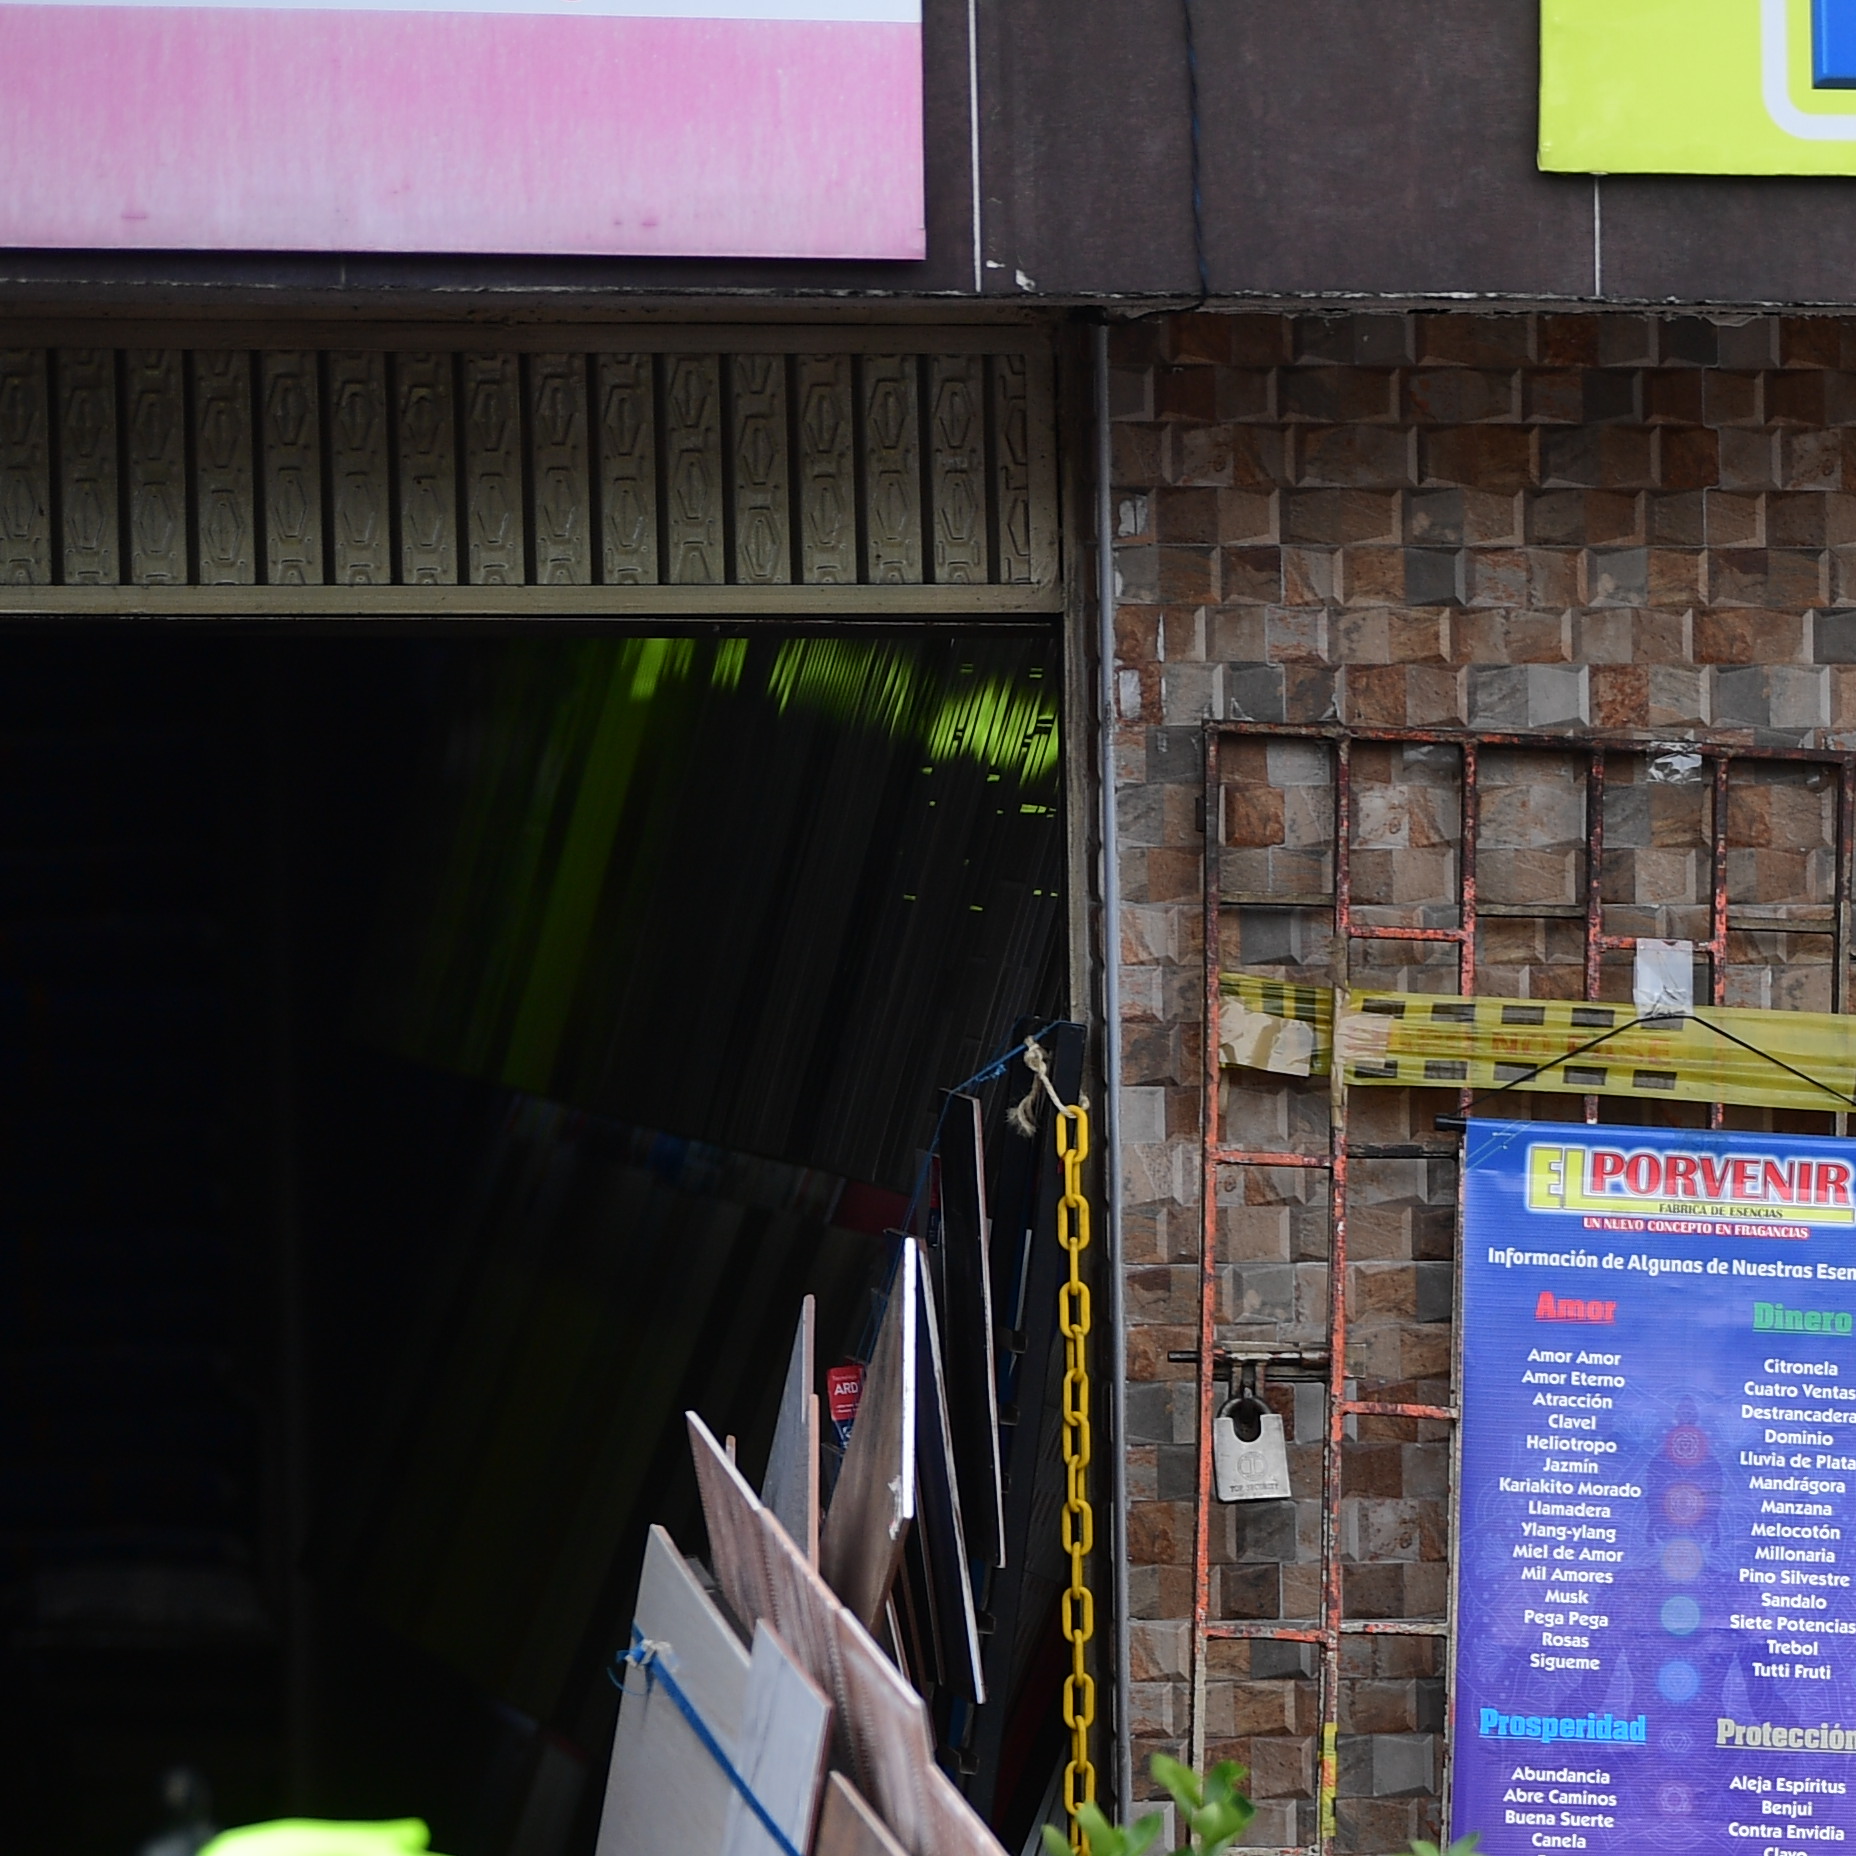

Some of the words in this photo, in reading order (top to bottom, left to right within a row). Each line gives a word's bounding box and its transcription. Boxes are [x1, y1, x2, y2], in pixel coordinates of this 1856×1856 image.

[1529, 1147, 1585, 1209] EL
[1591, 1152, 1849, 1205] PORVENIR
[1660, 1204, 1707, 1216] FABRICA
[1711, 1206, 1726, 1216] DE
[1729, 1207, 1783, 1218] ESENCIAS
[1584, 1218, 1601, 1229] UN
[1604, 1219, 1644, 1231] NUEVO
[1648, 1221, 1711, 1234] CONCEPTO
[1716, 1223, 1732, 1235] EN
[1735, 1225, 1808, 1239] FRAGANCIAS
[1488, 1247, 1599, 1269] Información
[1601, 1252, 1625, 1270] de
[1626, 1254, 1703, 1277] Algunas
[1706, 1257, 1729, 1275] de
[1732, 1259, 1813, 1279] Nuestras
[1536, 1291, 1616, 1324] Amor
[1753, 1302, 1852, 1334] Dinero
[1527, 1348, 1573, 1364] Amor
[1575, 1350, 1622, 1366] Amor
[1763, 1358, 1839, 1376] Citronela
[1521, 1369, 1567, 1385] Amor
[1570, 1371, 1626, 1388] Eterno
[1532, 1391, 1613, 1409] Atracción
[1743, 1381, 1799, 1398] Cuatro
[1801, 1383, 1856, 1401] Ventas
[1548, 1413, 1597, 1430] Clavel
[1526, 1434, 1617, 1456] Heliotropo
[1764, 1428, 1834, 1446] Dominio
[1542, 1457, 1599, 1474] Jazmín
[1739, 1450, 1786, 1468] Lluvia
[1789, 1453, 1813, 1469] de
[1816, 1454, 1856, 1471] Plata
[1499, 1476, 1574, 1495] Kariakito
[1577, 1481, 1642, 1498] Morado
[1748, 1475, 1846, 1495] Mandrágora
[1528, 1500, 1611, 1519] Llamadera
[1760, 1499, 1833, 1516] Manzana
[1521, 1521, 1617, 1544] Ylang-ylang
[1750, 1522, 1841, 1540] Melocotón
[1512, 1543, 1549, 1559] Miel
[1552, 1544, 1575, 1560] de
[1578, 1547, 1625, 1563] Amor
[1754, 1545, 1836, 1563] Millonaria
[1520, 1565, 1547, 1581] Mil
[1550, 1567, 1614, 1584] Amores
[1739, 1567, 1777, 1584] Pino
[1780, 1569, 1851, 1587] Silvestre
[1544, 1589, 1589, 1604] Musk
[1524, 1609, 1565, 1628] Pega
[1568, 1611, 1609, 1630] Pega
[1729, 1614, 1773, 1631] Siete
[1776, 1616, 1856, 1635] Potencias
[1542, 1631, 1590, 1648] Rosas
[1479, 1708, 1646, 1744] Prosperidad
[1510, 1766, 1611, 1785] Abundancia
[1505, 1809, 1556, 1826] Buena
[1559, 1811, 1615, 1828] Suerte
[1761, 1799, 1813, 1819] Benjui
[1728, 1821, 1783, 1839] Contra
[1786, 1824, 1845, 1841] Envidia
